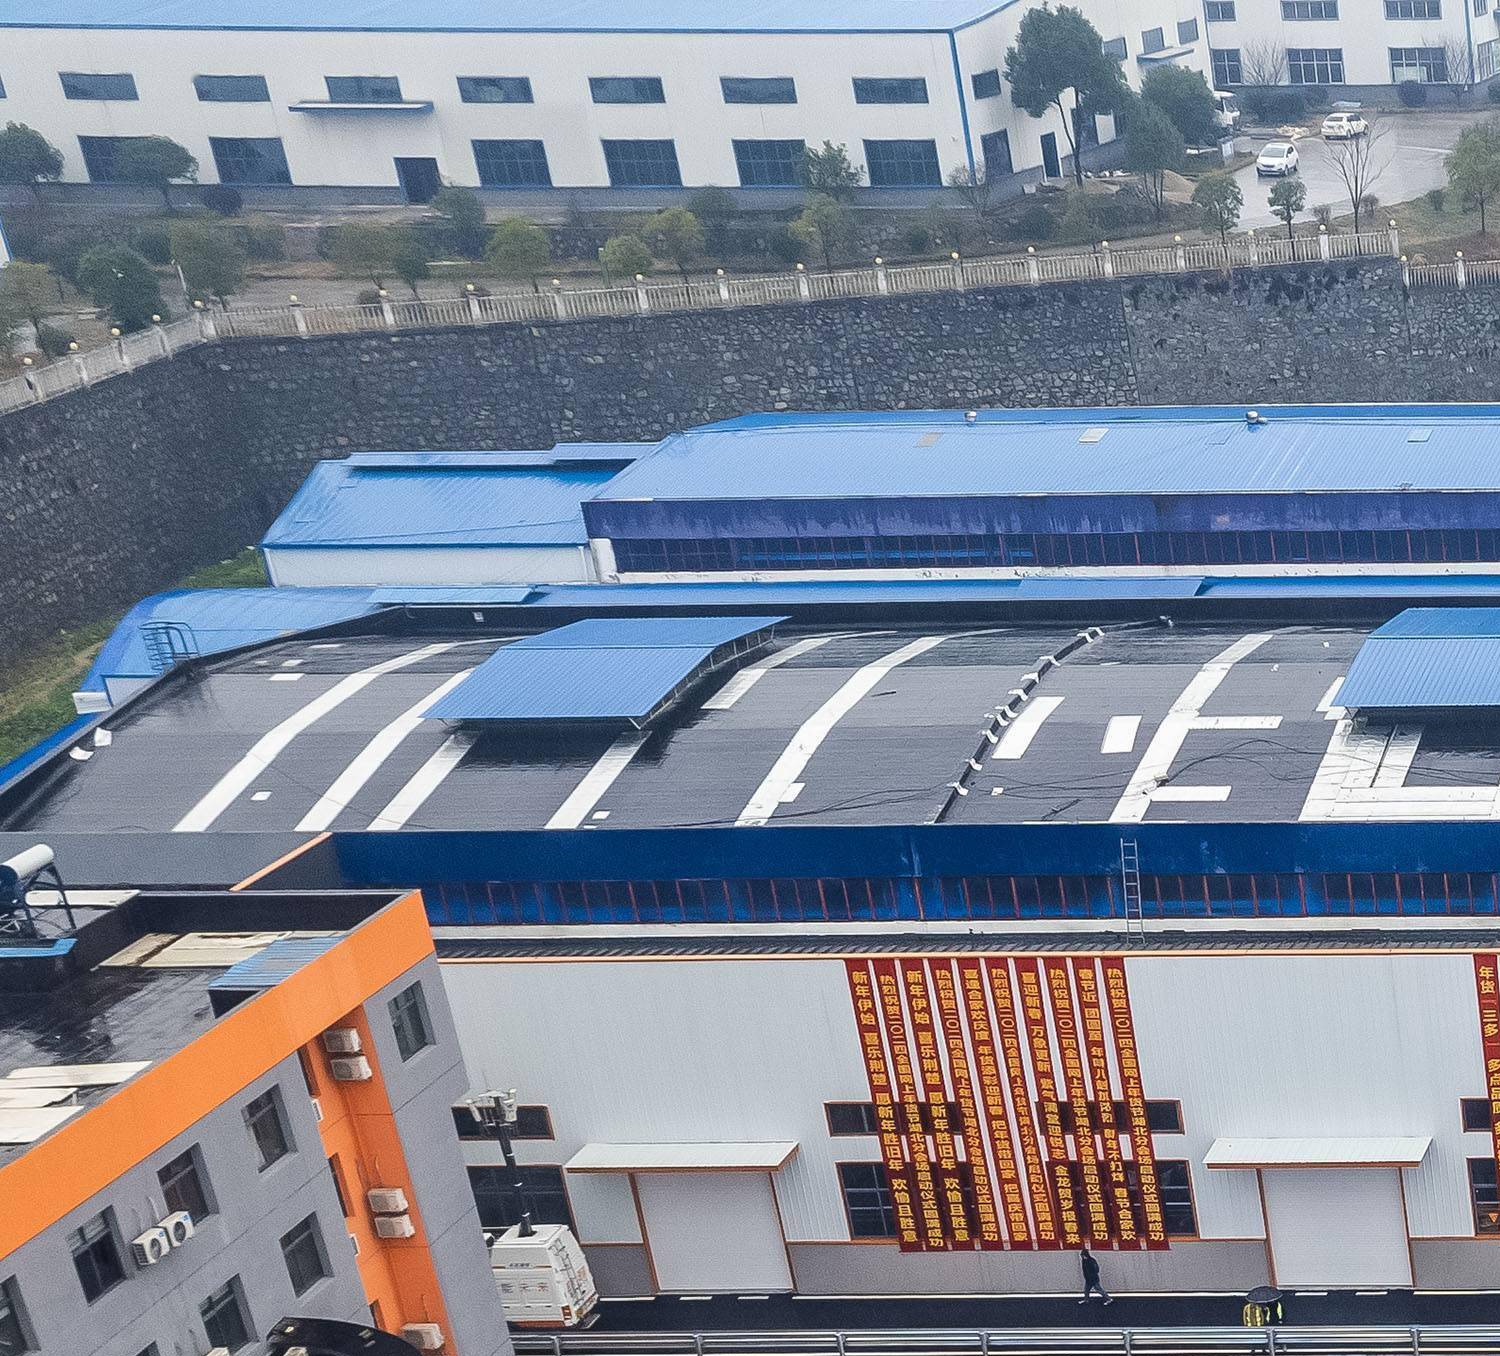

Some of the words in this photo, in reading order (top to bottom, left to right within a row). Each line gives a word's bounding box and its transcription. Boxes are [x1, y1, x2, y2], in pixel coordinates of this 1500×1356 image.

[853, 972, 875, 1024] 新年伊始
[907, 971, 929, 1024] 新年伊始
